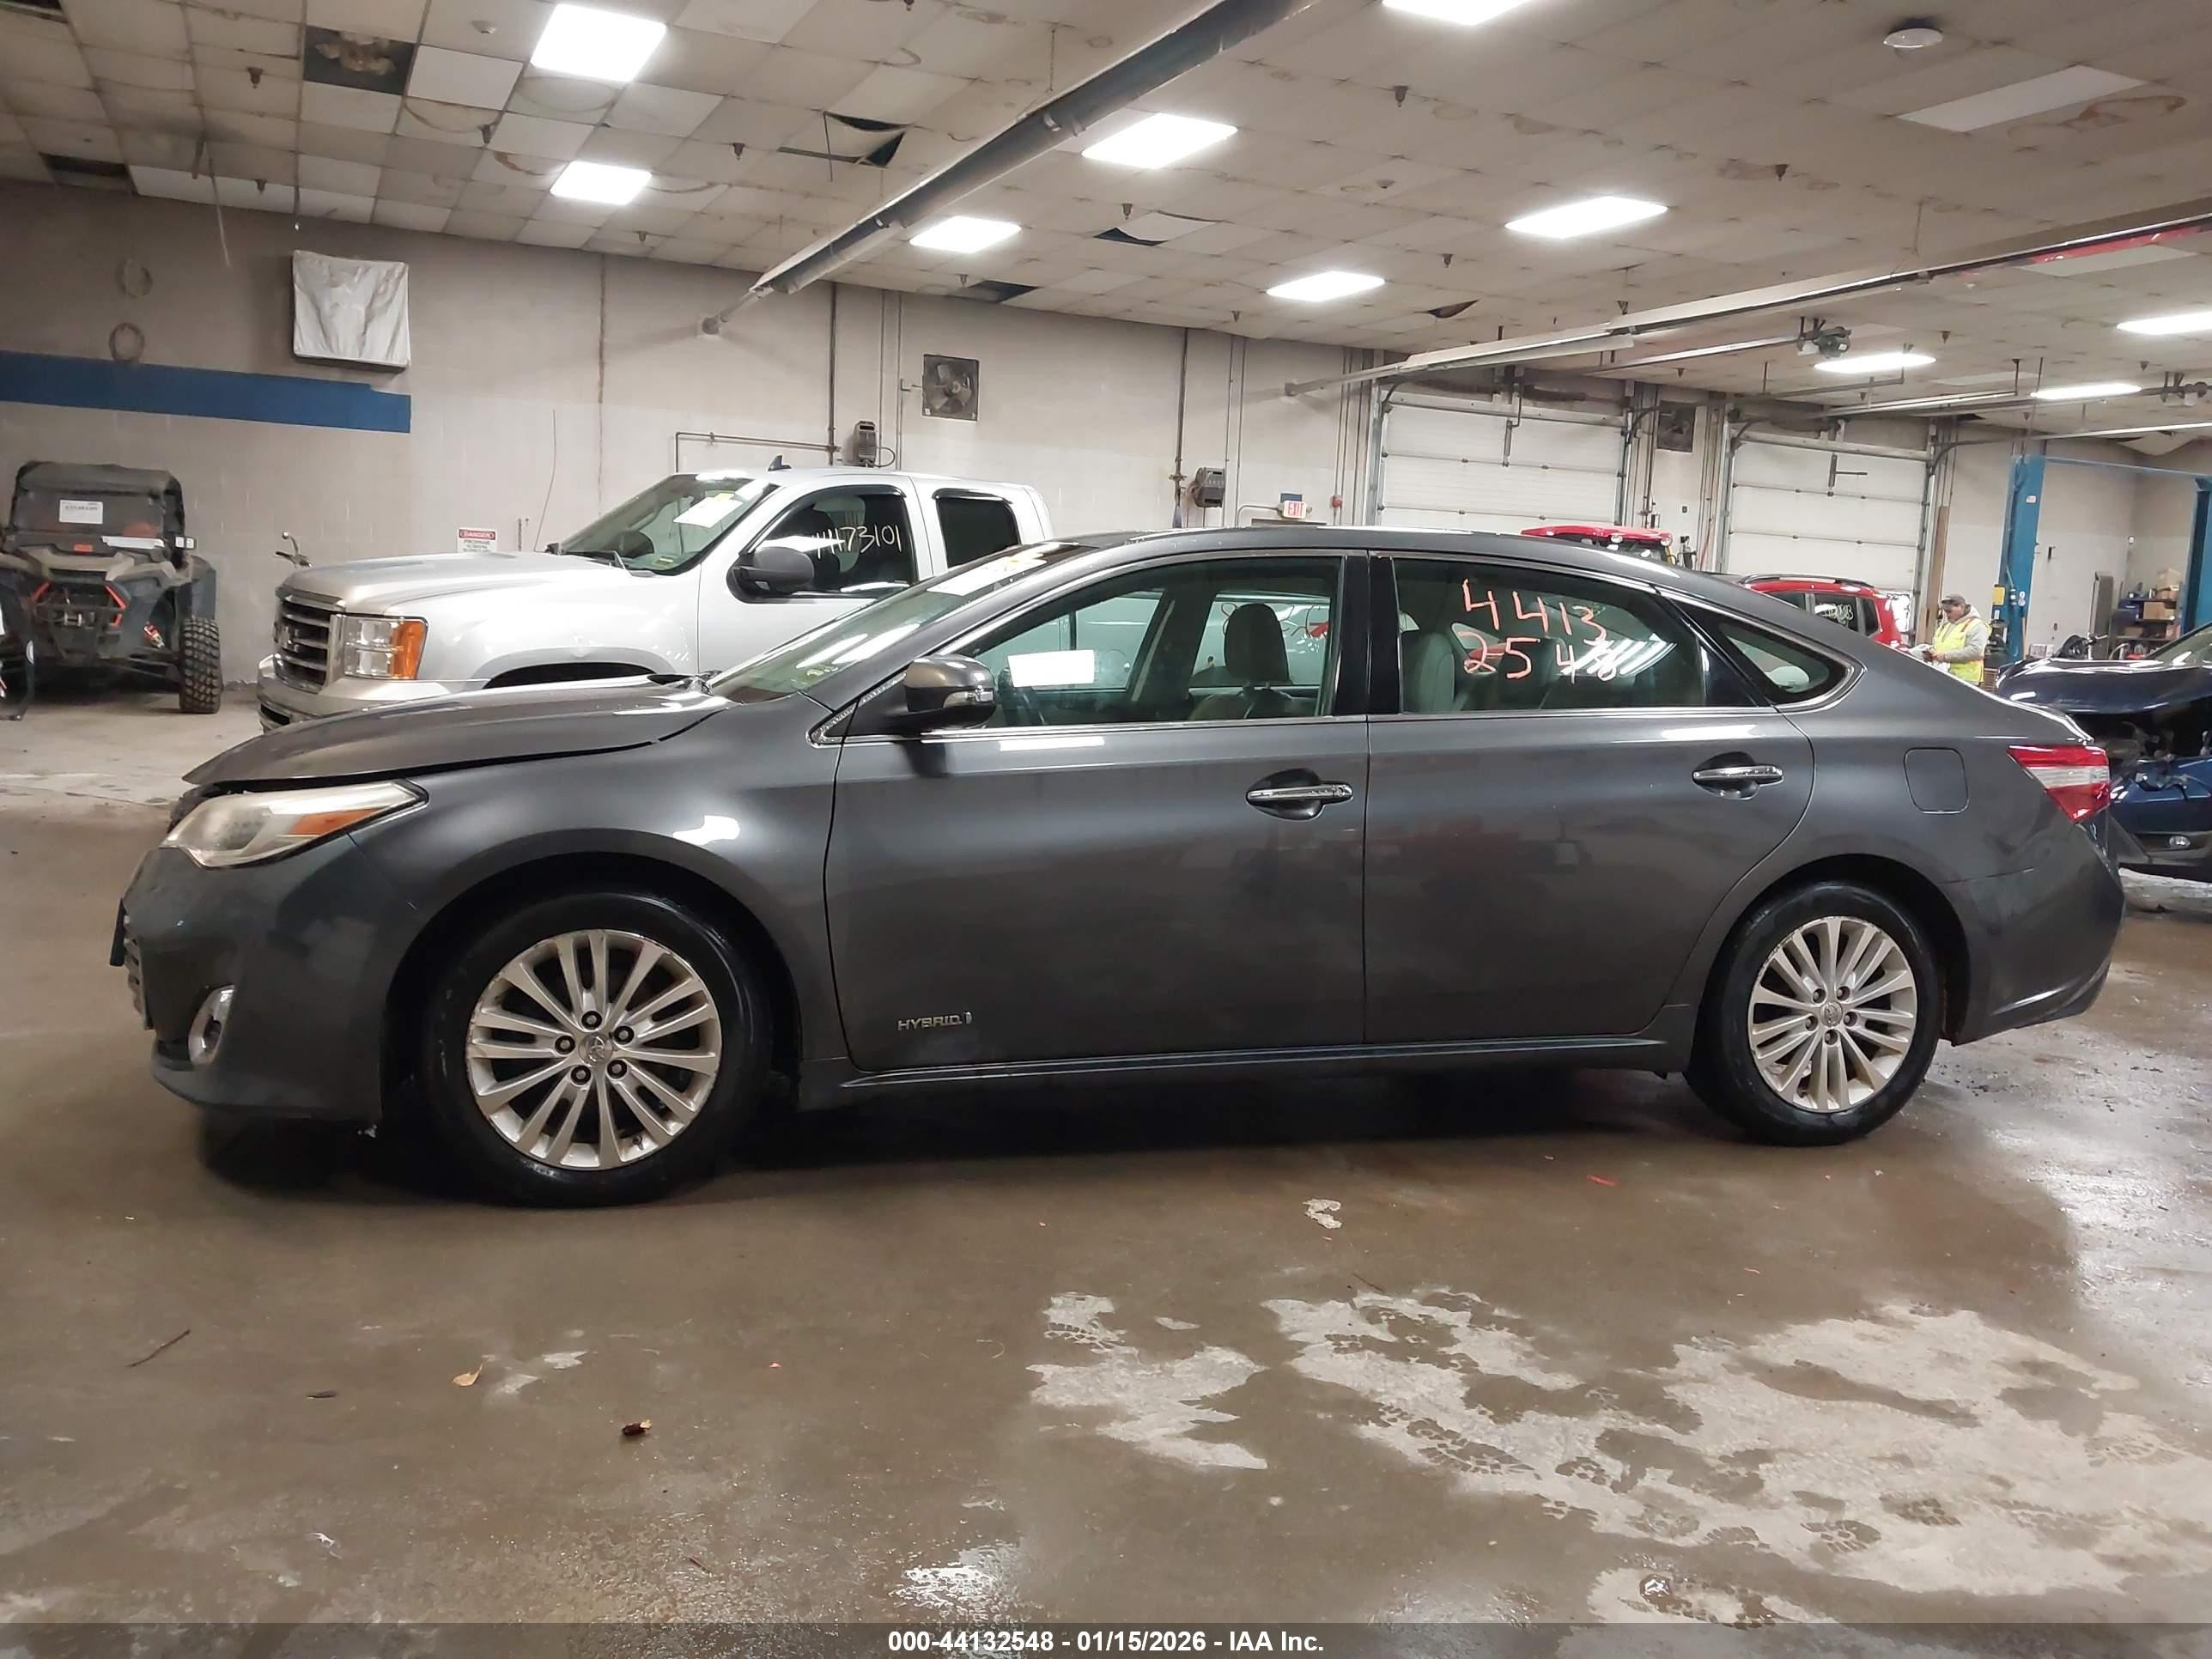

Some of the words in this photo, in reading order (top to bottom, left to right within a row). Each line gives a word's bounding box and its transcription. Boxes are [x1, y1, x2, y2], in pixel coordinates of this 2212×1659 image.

[1287, 501, 1304, 517] EXIT
[460, 530, 495, 539] DANGER
[897, 1014, 962, 1030] HYBRID
